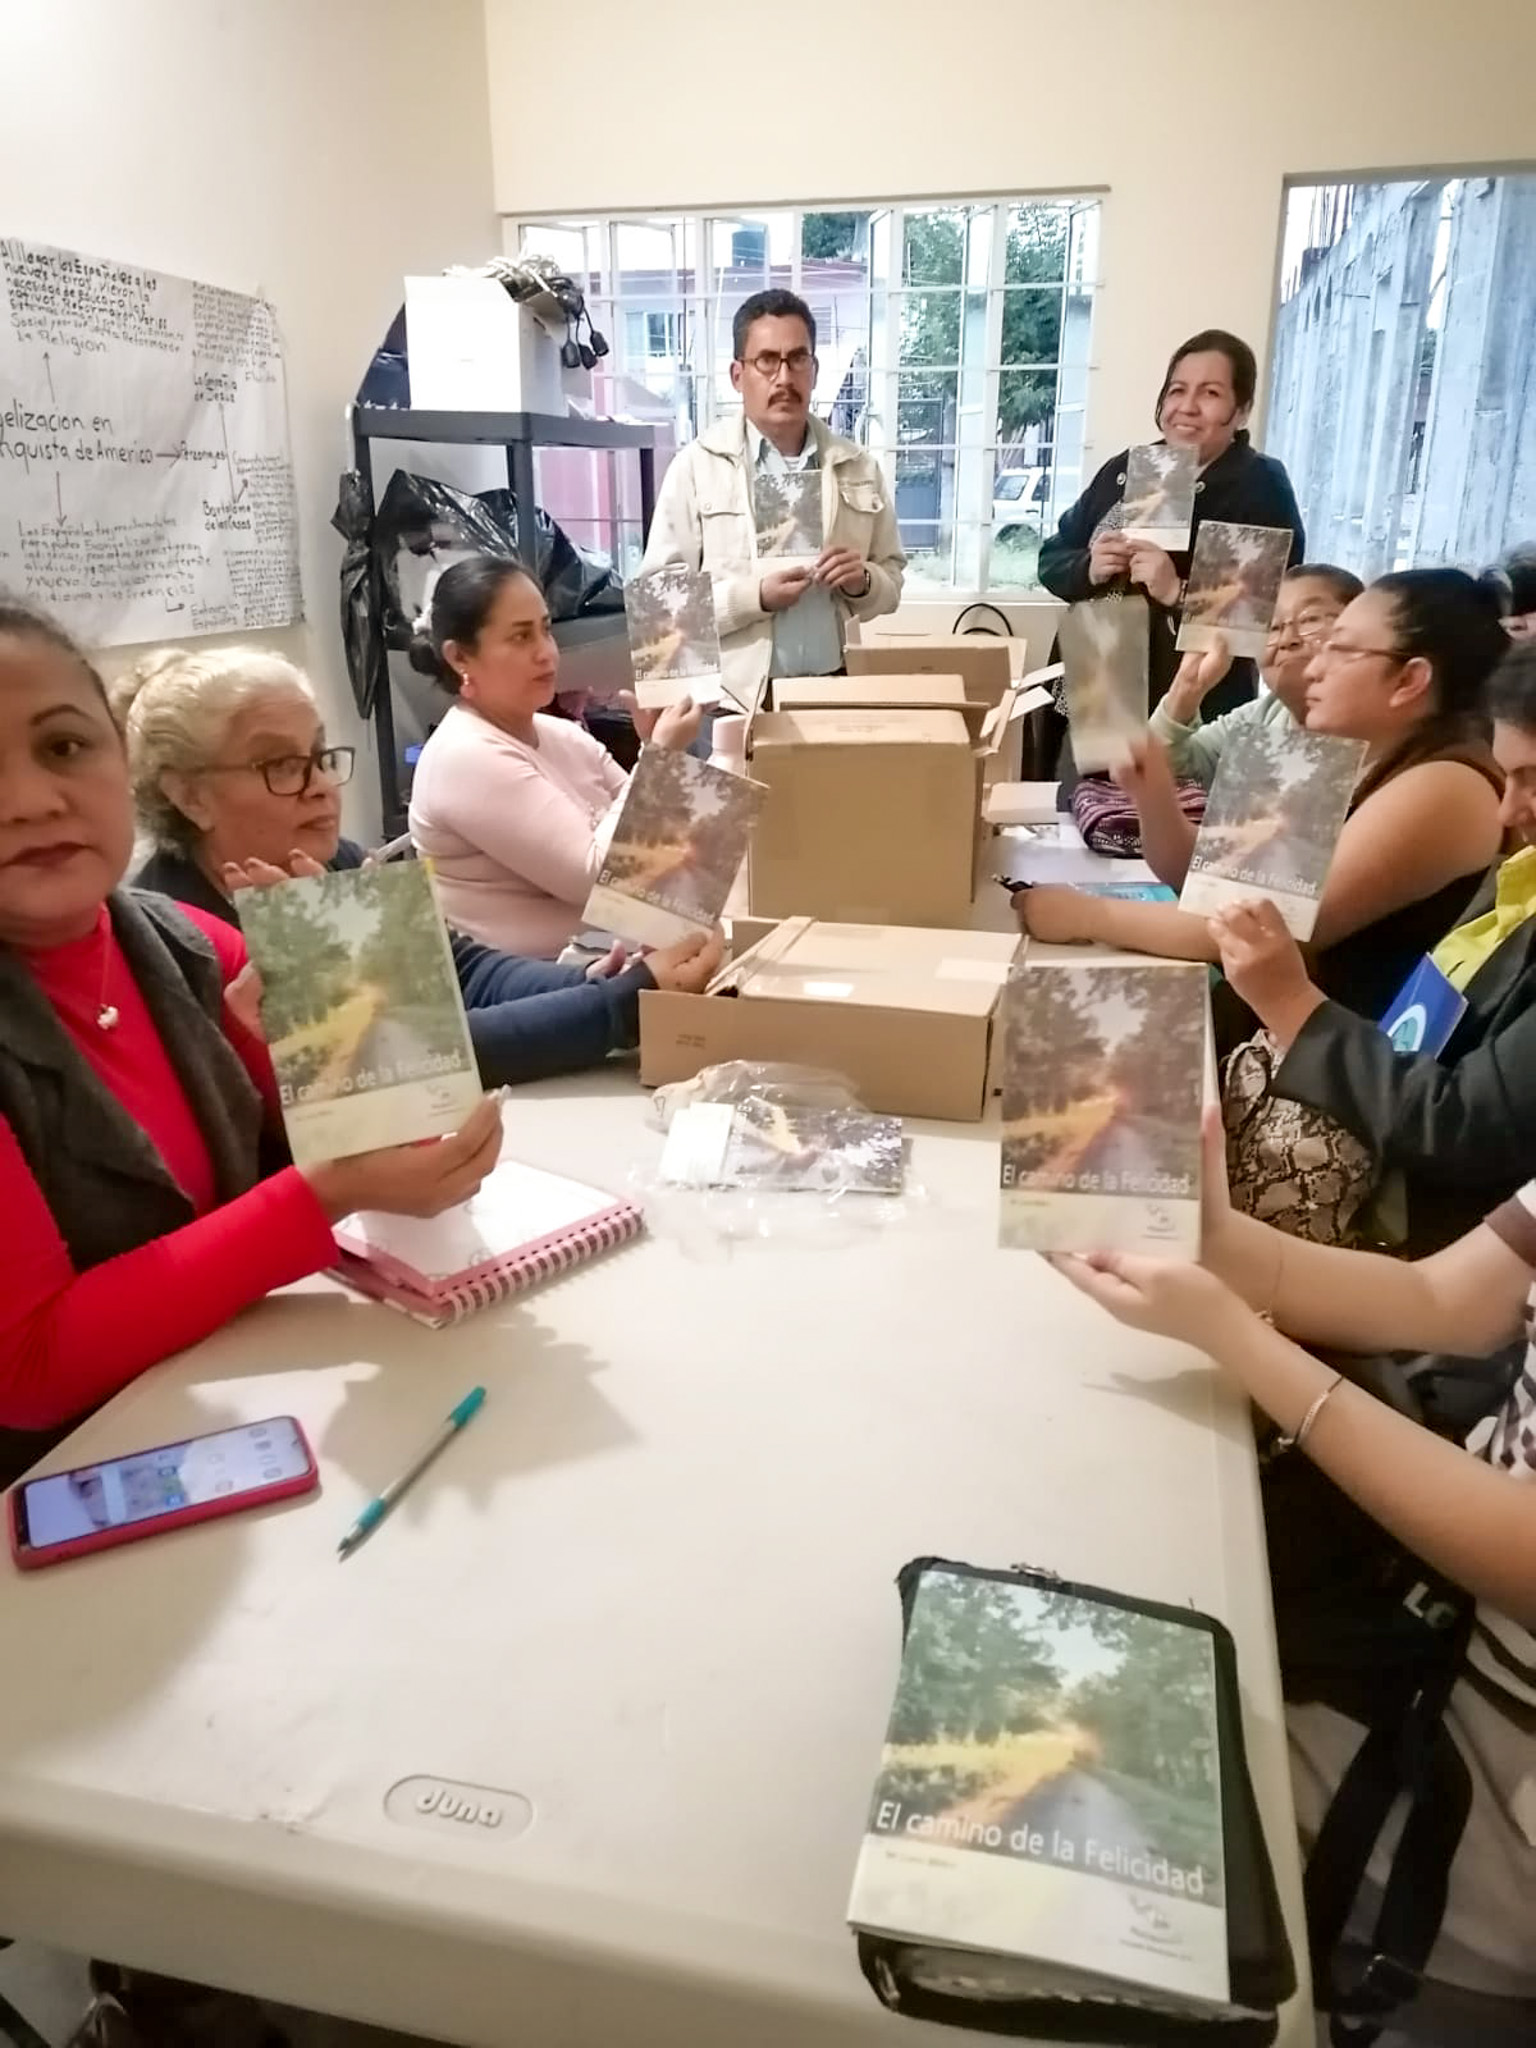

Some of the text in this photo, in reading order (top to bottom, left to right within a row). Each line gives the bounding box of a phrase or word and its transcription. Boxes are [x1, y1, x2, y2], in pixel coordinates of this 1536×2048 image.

[93, 416, 113, 435] en
[76, 437, 94, 461] de
[1192, 855, 1202, 870] El
[1240, 867, 1255, 881] de
[1269, 873, 1317, 896] Fecidad
[279, 1084, 294, 1105] El
[356, 1068, 377, 1088] de
[1002, 1163, 1016, 1184] El
[1078, 1170, 1100, 1190] de
[1103, 1170, 1118, 1191] la
[416, 1788, 503, 1828] duna
[875, 1801, 1206, 1896] El camino de la Felicidad
